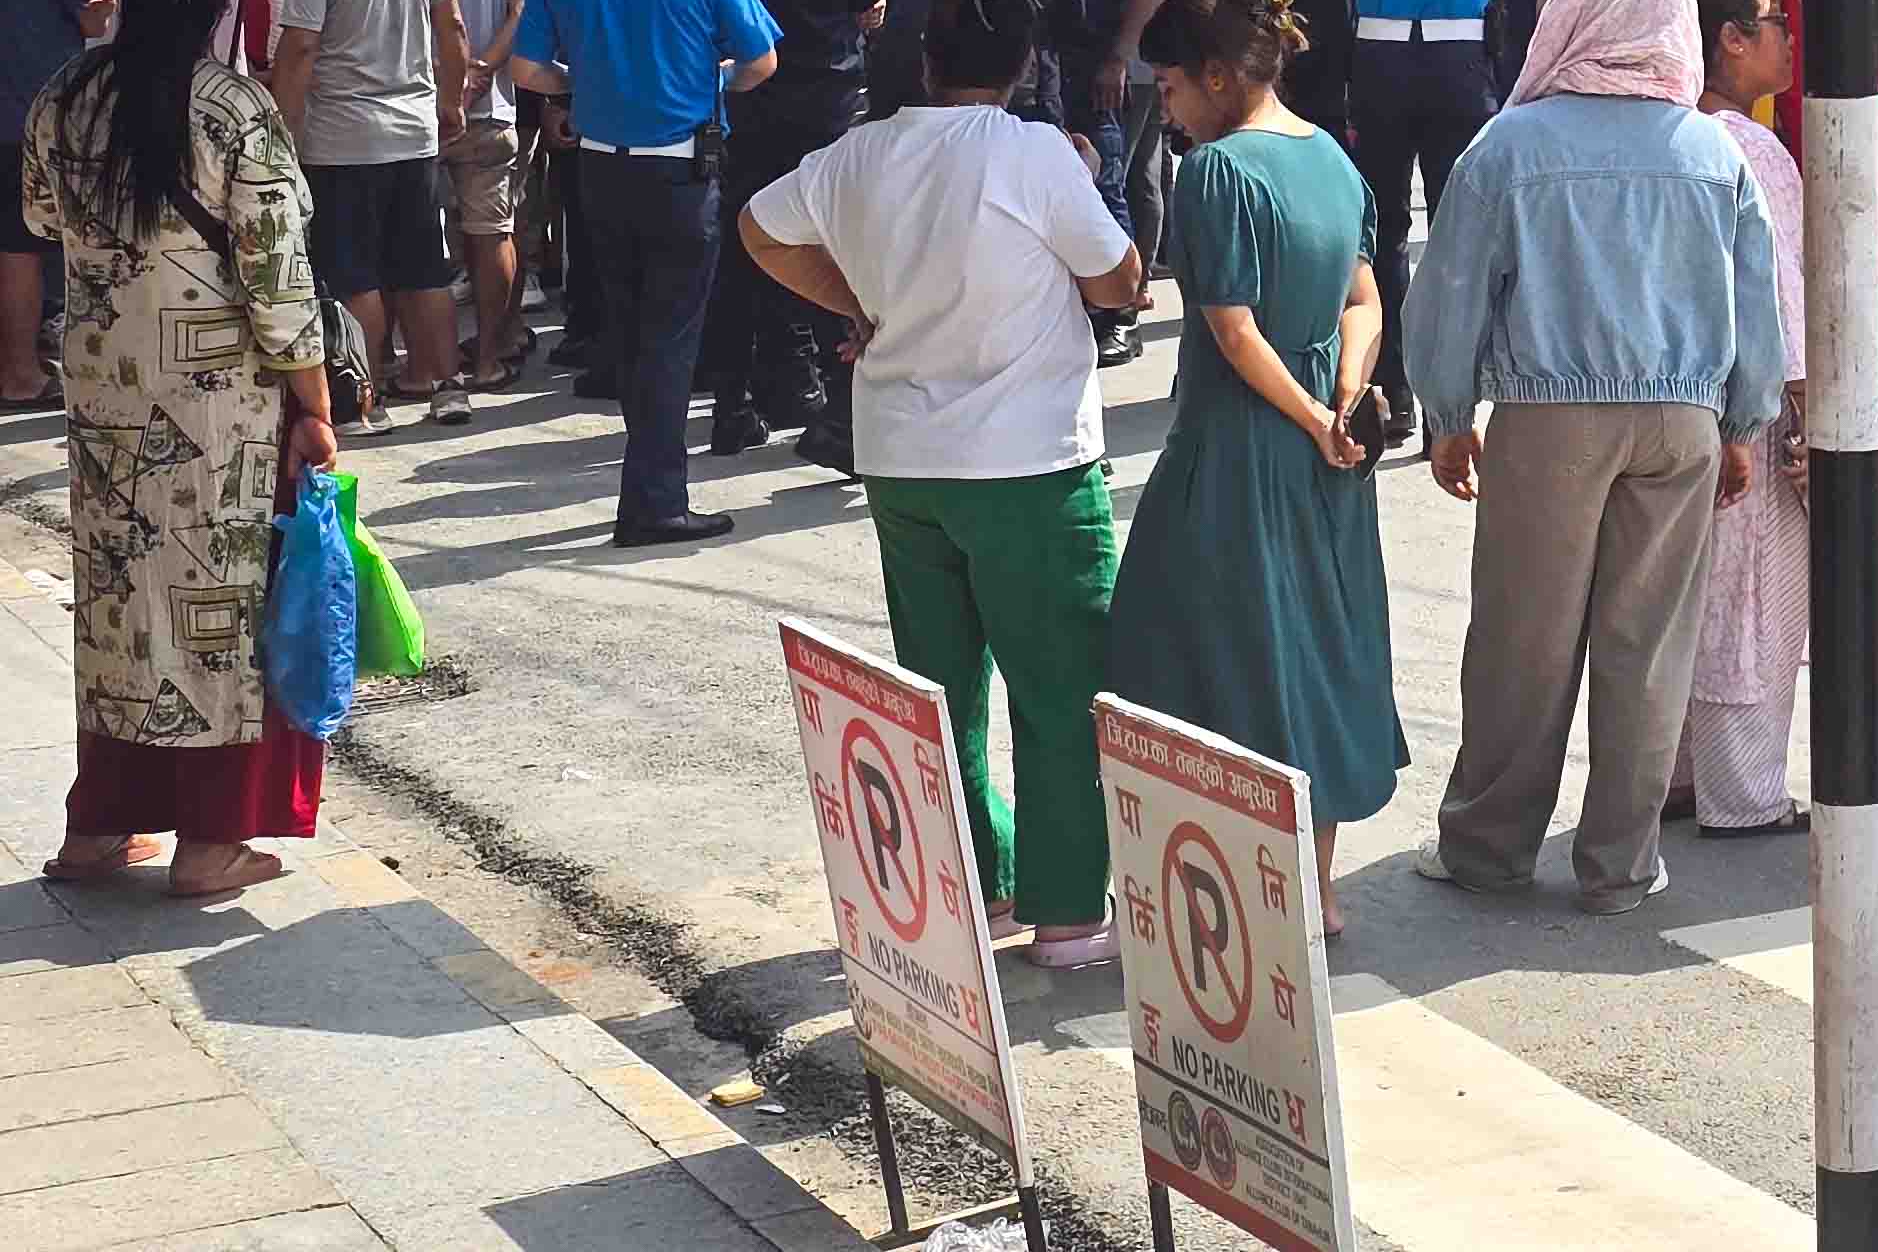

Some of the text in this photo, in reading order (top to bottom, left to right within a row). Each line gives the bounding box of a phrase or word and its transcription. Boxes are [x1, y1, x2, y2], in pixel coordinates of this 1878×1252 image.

[857, 758, 902, 891] P
[868, 931, 892, 981] NO
[895, 949, 960, 1020] PARKING
[1183, 860, 1229, 992] P
[1171, 1035, 1198, 1079] NO
[1202, 1051, 1281, 1125] PARKING
